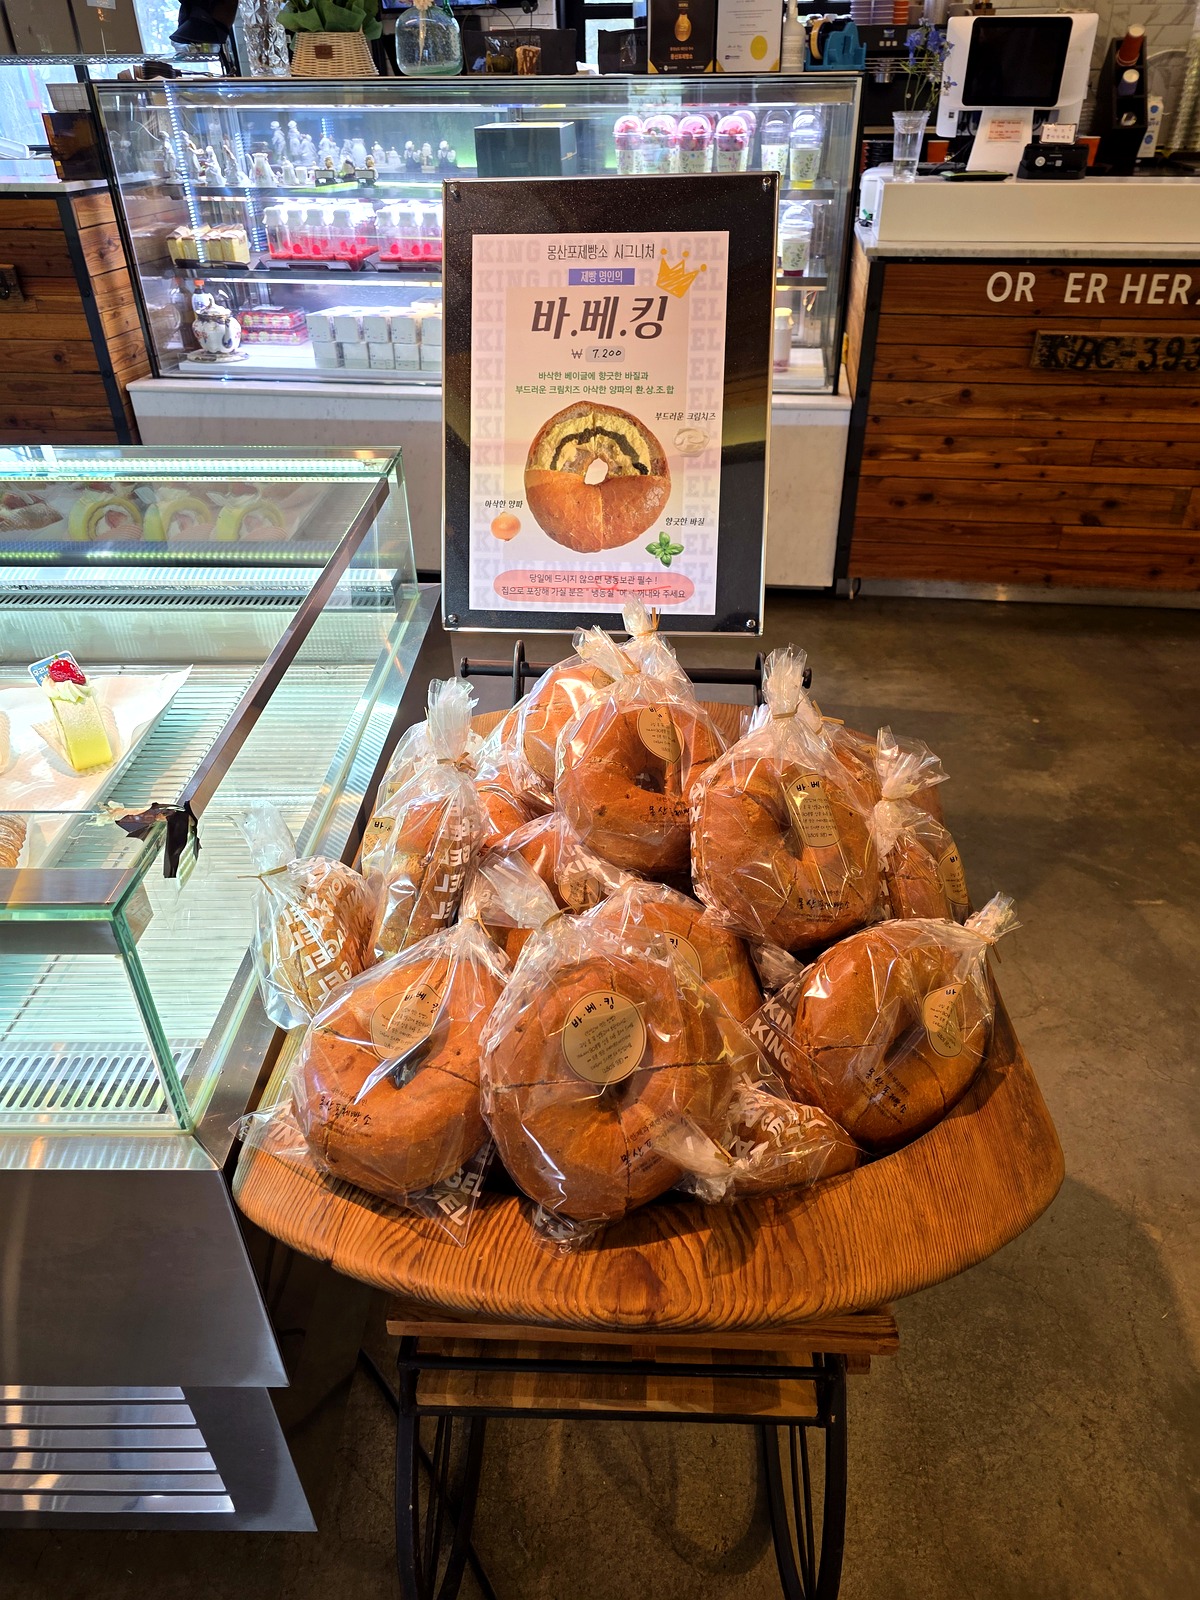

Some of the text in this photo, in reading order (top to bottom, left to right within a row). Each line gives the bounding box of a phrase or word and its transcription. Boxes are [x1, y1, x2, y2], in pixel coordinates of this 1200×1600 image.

[547, 243, 655, 260] 몽산포제빵소 시그니처
[580, 270, 623, 283] 제빵 명인의
[1119, 273, 1200, 305] HER
[531, 296, 669, 340] 바.베.킹
[538, 371, 649, 381] 바삭한 베이글에 향긋한 바질과
[515, 385, 547, 395] 부드러운
[549, 385, 581, 395] 크림치즈
[582, 385, 607, 395] 아삭한
[609, 385, 633, 395] 양파의
[654, 411, 716, 422] 부드러운 크림치즈
[484, 499, 524, 509] 아삭한 양파
[665, 517, 705, 526] 향긋한 바질
[529, 574, 552, 583] 당일에
[554, 574, 577, 584] 드시지
[579, 574, 602, 584] 않으면
[604, 575, 635, 585] 냉동보관
[637, 575, 652, 585] 필수
[501, 586, 525, 596] 집으로
[526, 587, 549, 596] 포장해
[551, 587, 567, 597] 가실
[568, 587, 584, 597] 분은
[663, 590, 686, 599] 주세요
